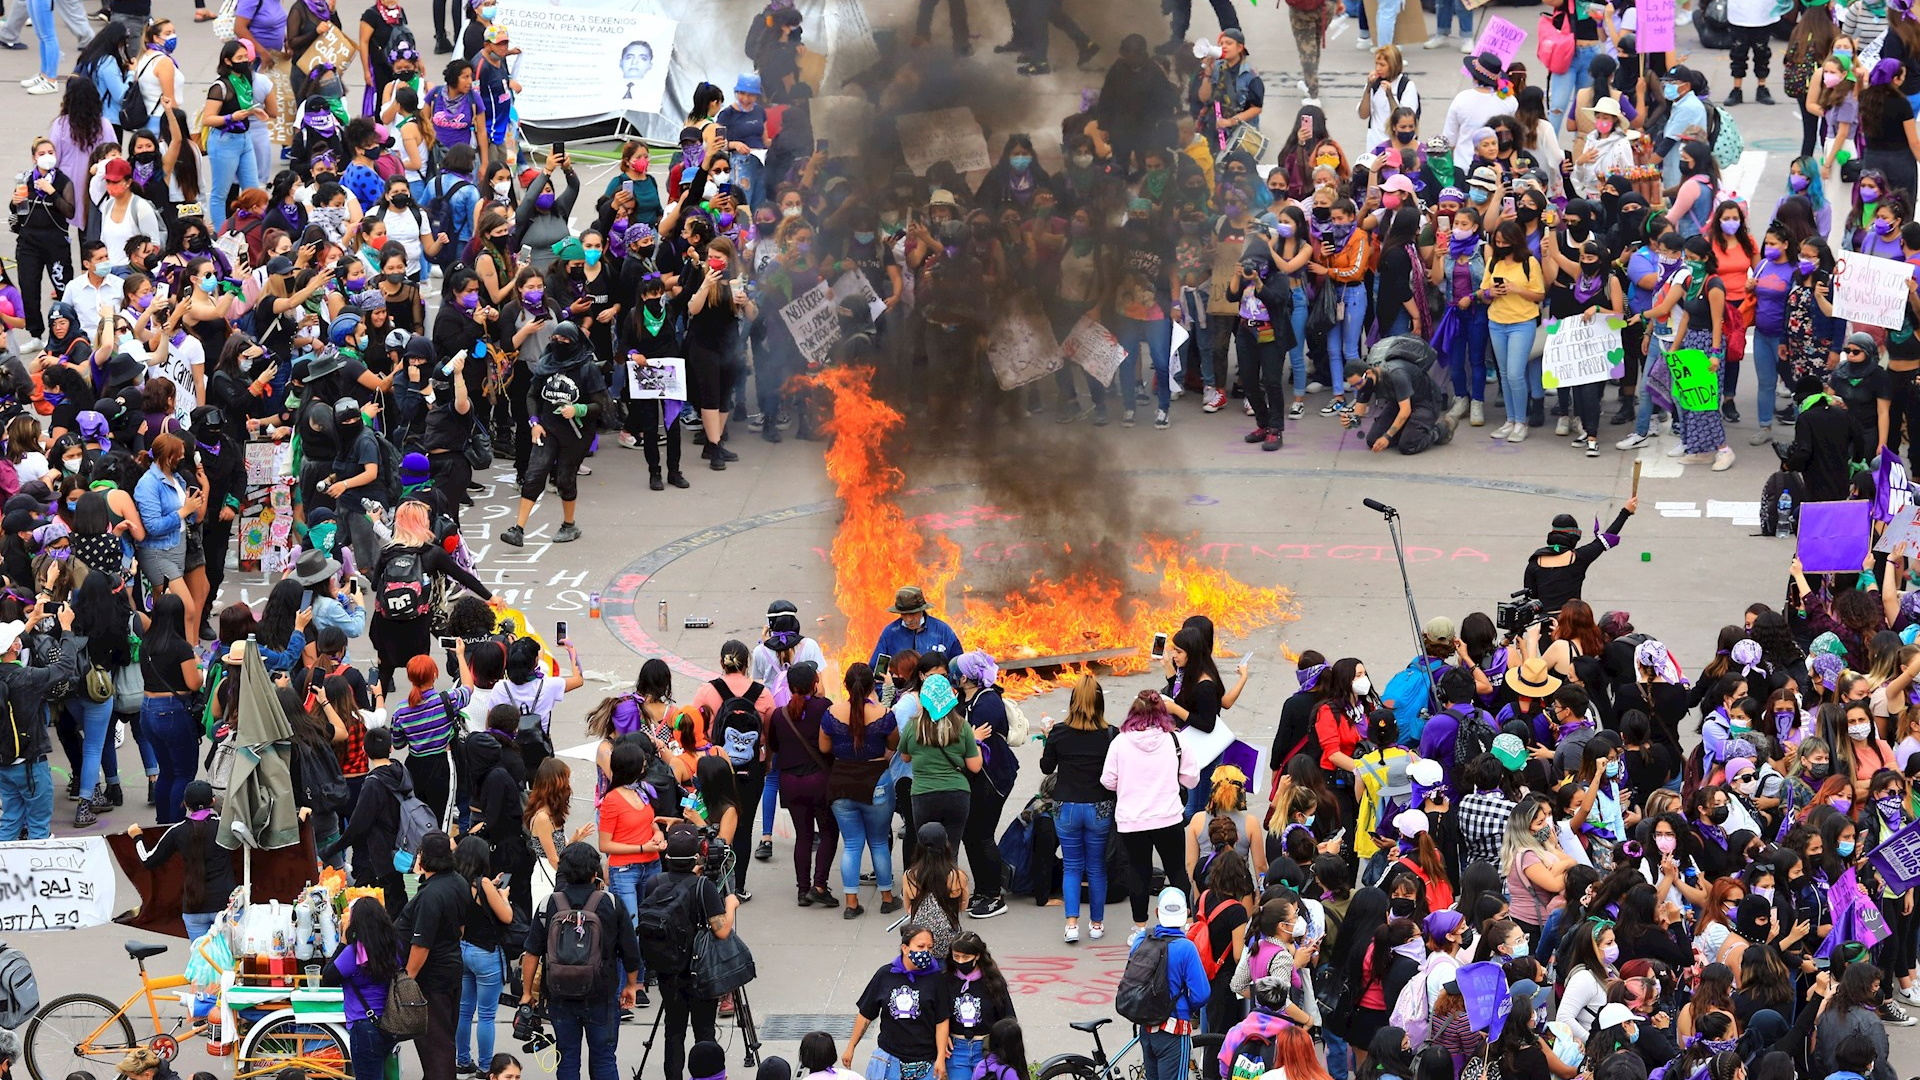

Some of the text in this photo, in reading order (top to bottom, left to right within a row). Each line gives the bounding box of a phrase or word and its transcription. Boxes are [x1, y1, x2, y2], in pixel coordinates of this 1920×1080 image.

[498, 8, 638, 26] STE CASO TOCA 3 SEXENIOS
[588, 25, 596, 33] Y
[597, 25, 625, 34] AMLO
[1133, 540, 1491, 564] MINICIDA
[1904, 832, 1918, 848] NI
